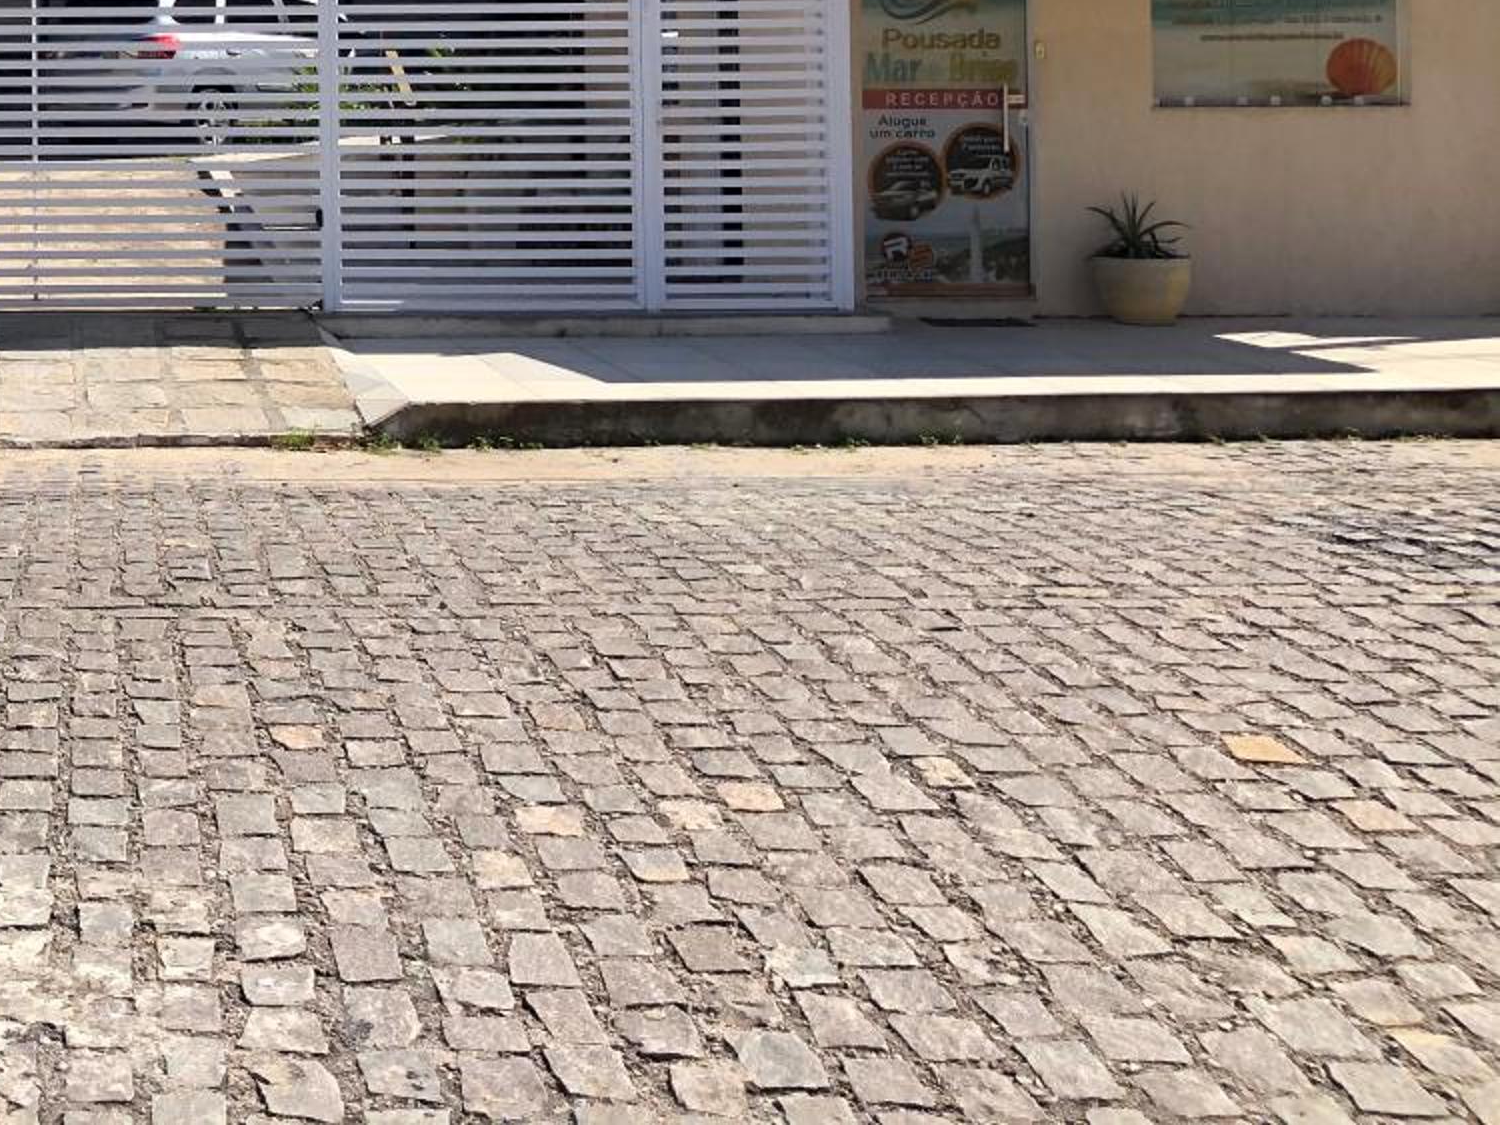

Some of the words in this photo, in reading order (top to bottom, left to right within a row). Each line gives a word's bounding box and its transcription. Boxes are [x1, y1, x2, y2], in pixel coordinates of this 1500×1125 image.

[882, 27, 1001, 50] Pousada
[866, 52, 922, 82] Mar
[885, 90, 999, 108] RECEPÇÃO
[878, 114, 927, 128] Alugue
[895, 129, 936, 139] carro
